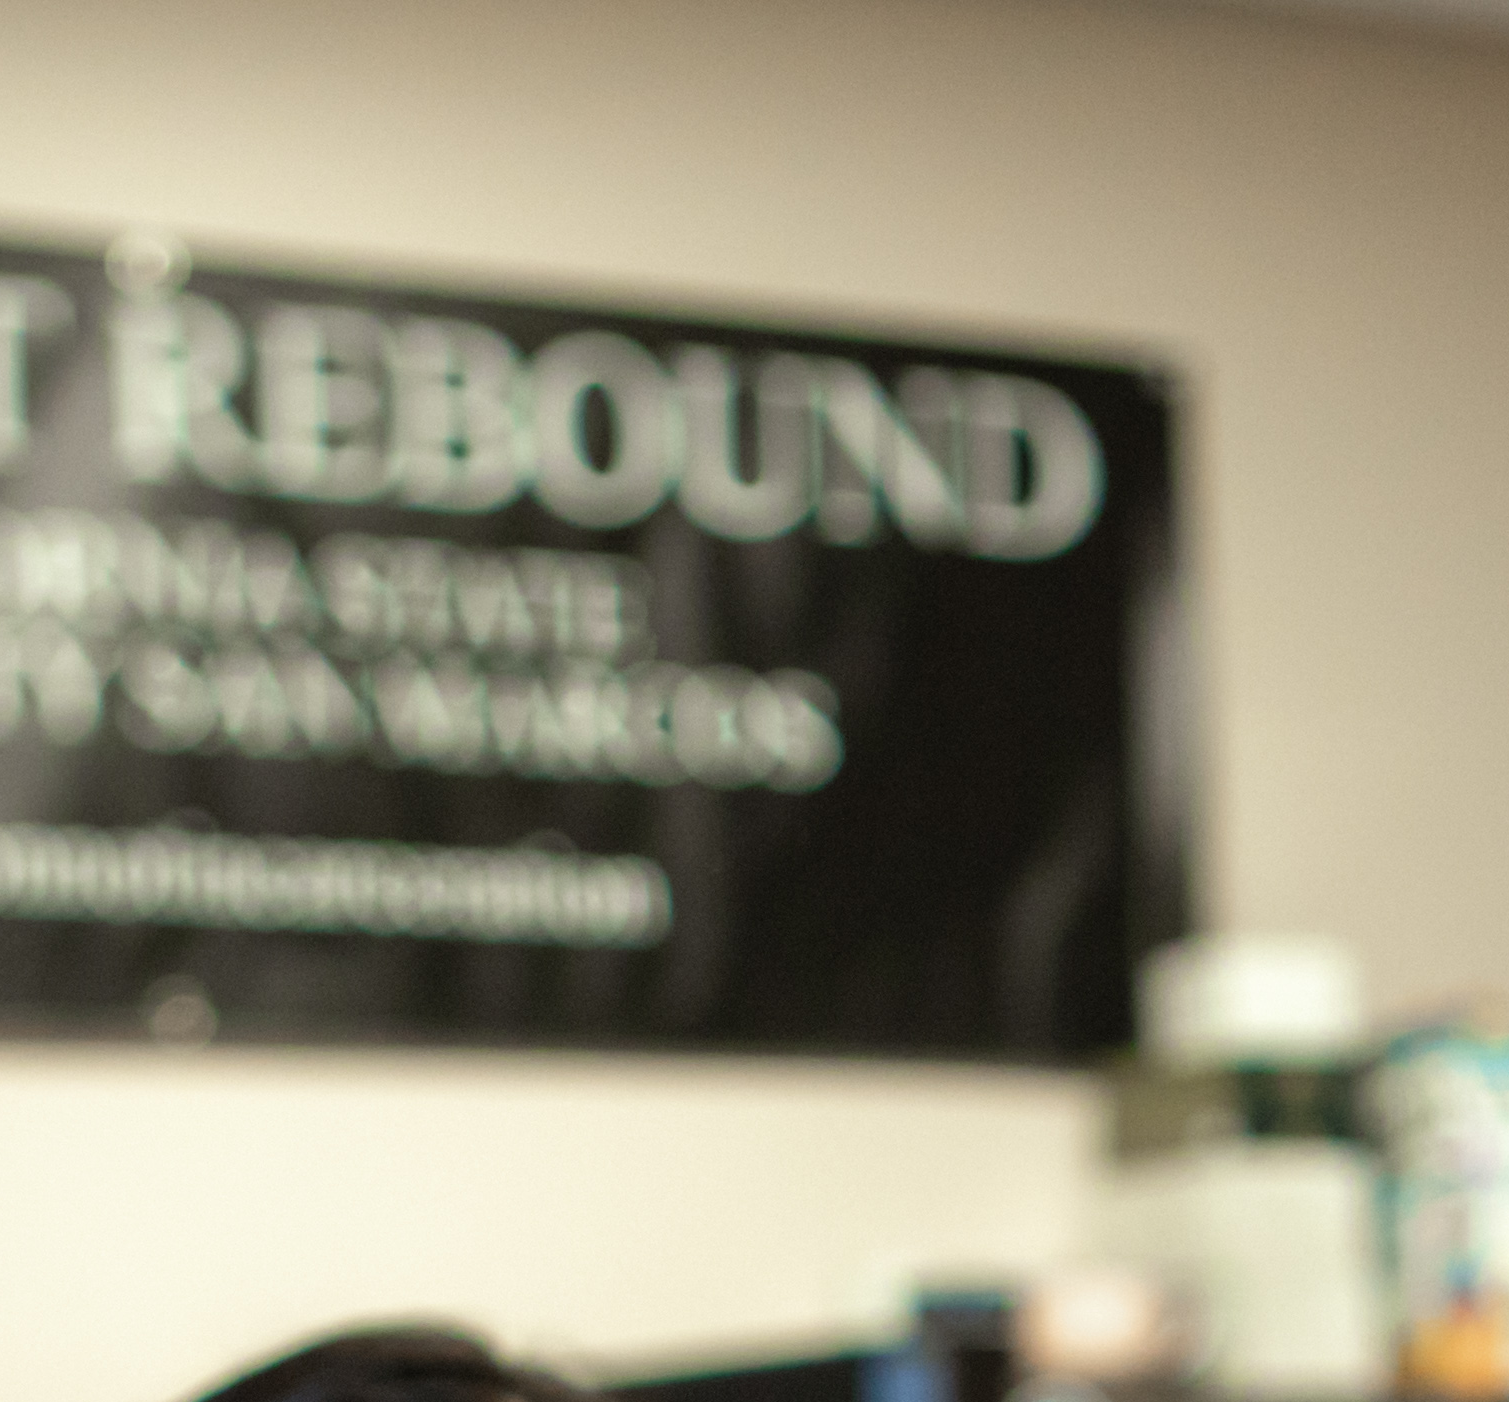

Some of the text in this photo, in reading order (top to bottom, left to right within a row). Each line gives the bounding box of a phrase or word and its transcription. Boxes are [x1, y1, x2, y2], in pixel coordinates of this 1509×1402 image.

[113, 292, 1096, 555] REBOUND
[331, 530, 656, 660] STATE
[129, 630, 359, 754] SAN
[377, 650, 840, 788] MARCOS
